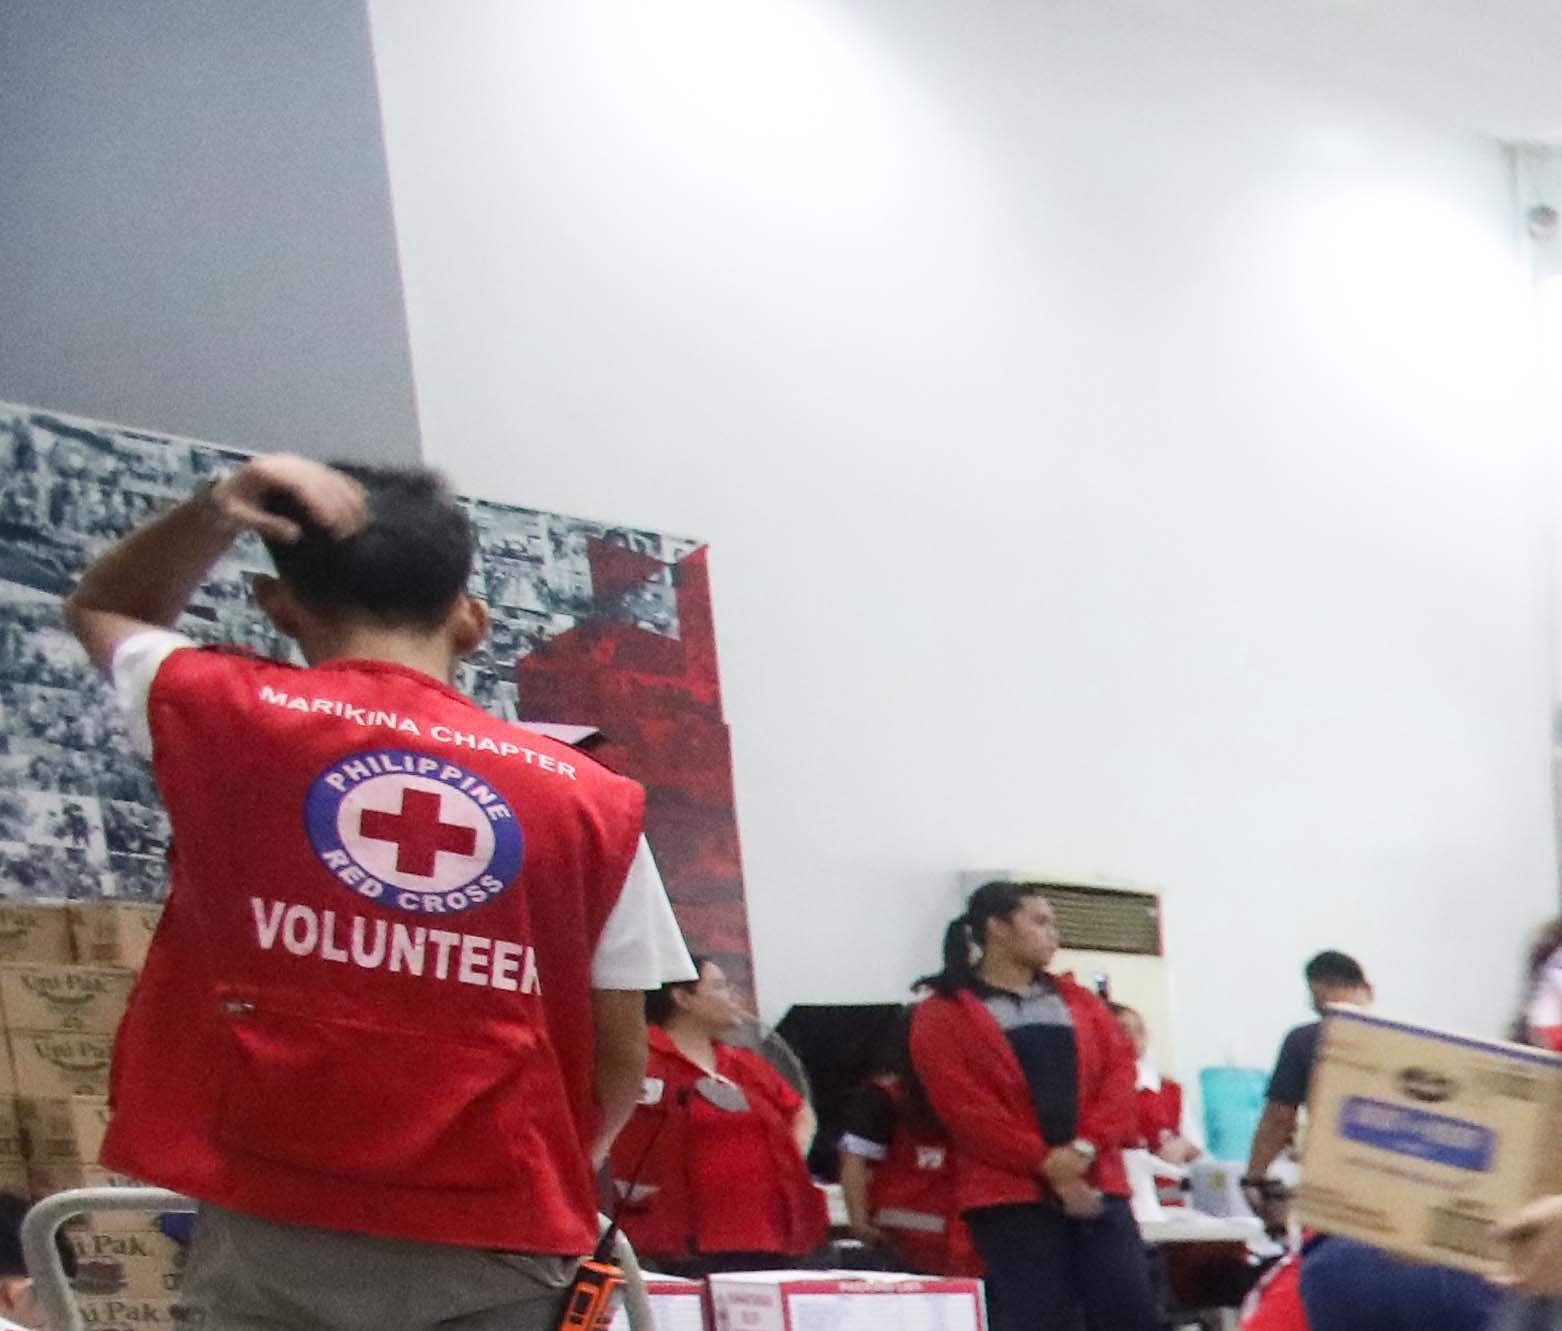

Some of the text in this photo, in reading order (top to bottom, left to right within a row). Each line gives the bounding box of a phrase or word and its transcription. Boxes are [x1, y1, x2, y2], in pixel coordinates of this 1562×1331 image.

[258, 686, 577, 781] MARIKINA CHAPTER
[324, 753, 512, 822] PHILIPPINE
[322, 848, 505, 914] RED CROSS
